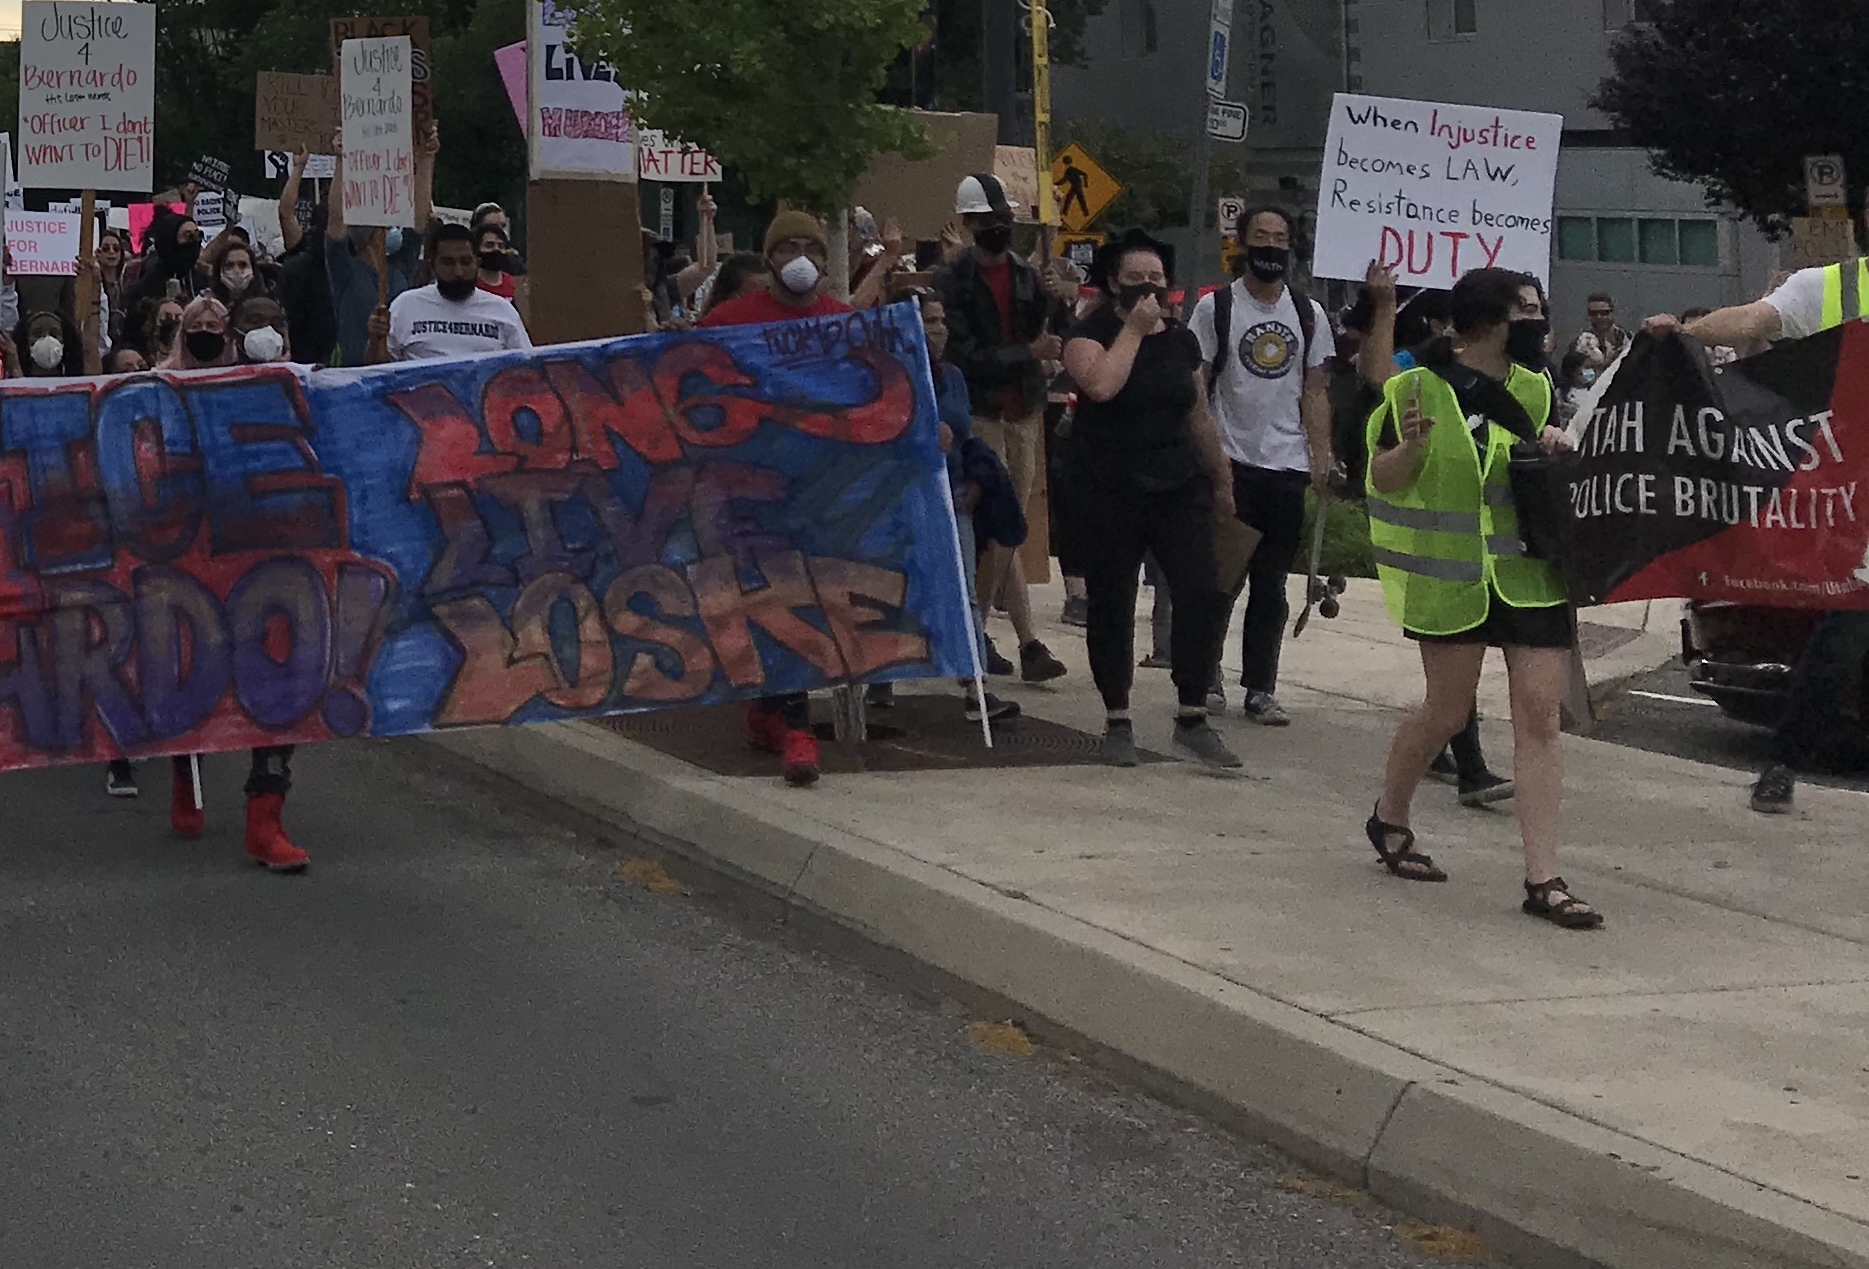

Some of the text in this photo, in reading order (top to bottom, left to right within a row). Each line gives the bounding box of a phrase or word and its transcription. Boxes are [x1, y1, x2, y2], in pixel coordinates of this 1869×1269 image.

[41, 1, 129, 42] Justice
[77, 42, 93, 66] 4
[24, 63, 138, 92] Bernardo
[372, 77, 382, 97] 4
[99, 114, 113, 131] I
[1347, 105, 1537, 150] When Injustice
[24, 143, 75, 166] WANT
[1336, 136, 1520, 187] becomes LAW,
[1330, 177, 1552, 235] Resistance becomes
[6, 220, 68, 235] JUSTICE
[7, 239, 39, 253] FOR
[1253, 257, 1284, 272] MATH
[1379, 224, 1505, 278] DUTY
[387, 339, 917, 502] LONG
[1580, 400, 1645, 459] TAH
[1672, 475, 1858, 530] BRUTALITY
[420, 459, 792, 596] LIVE
